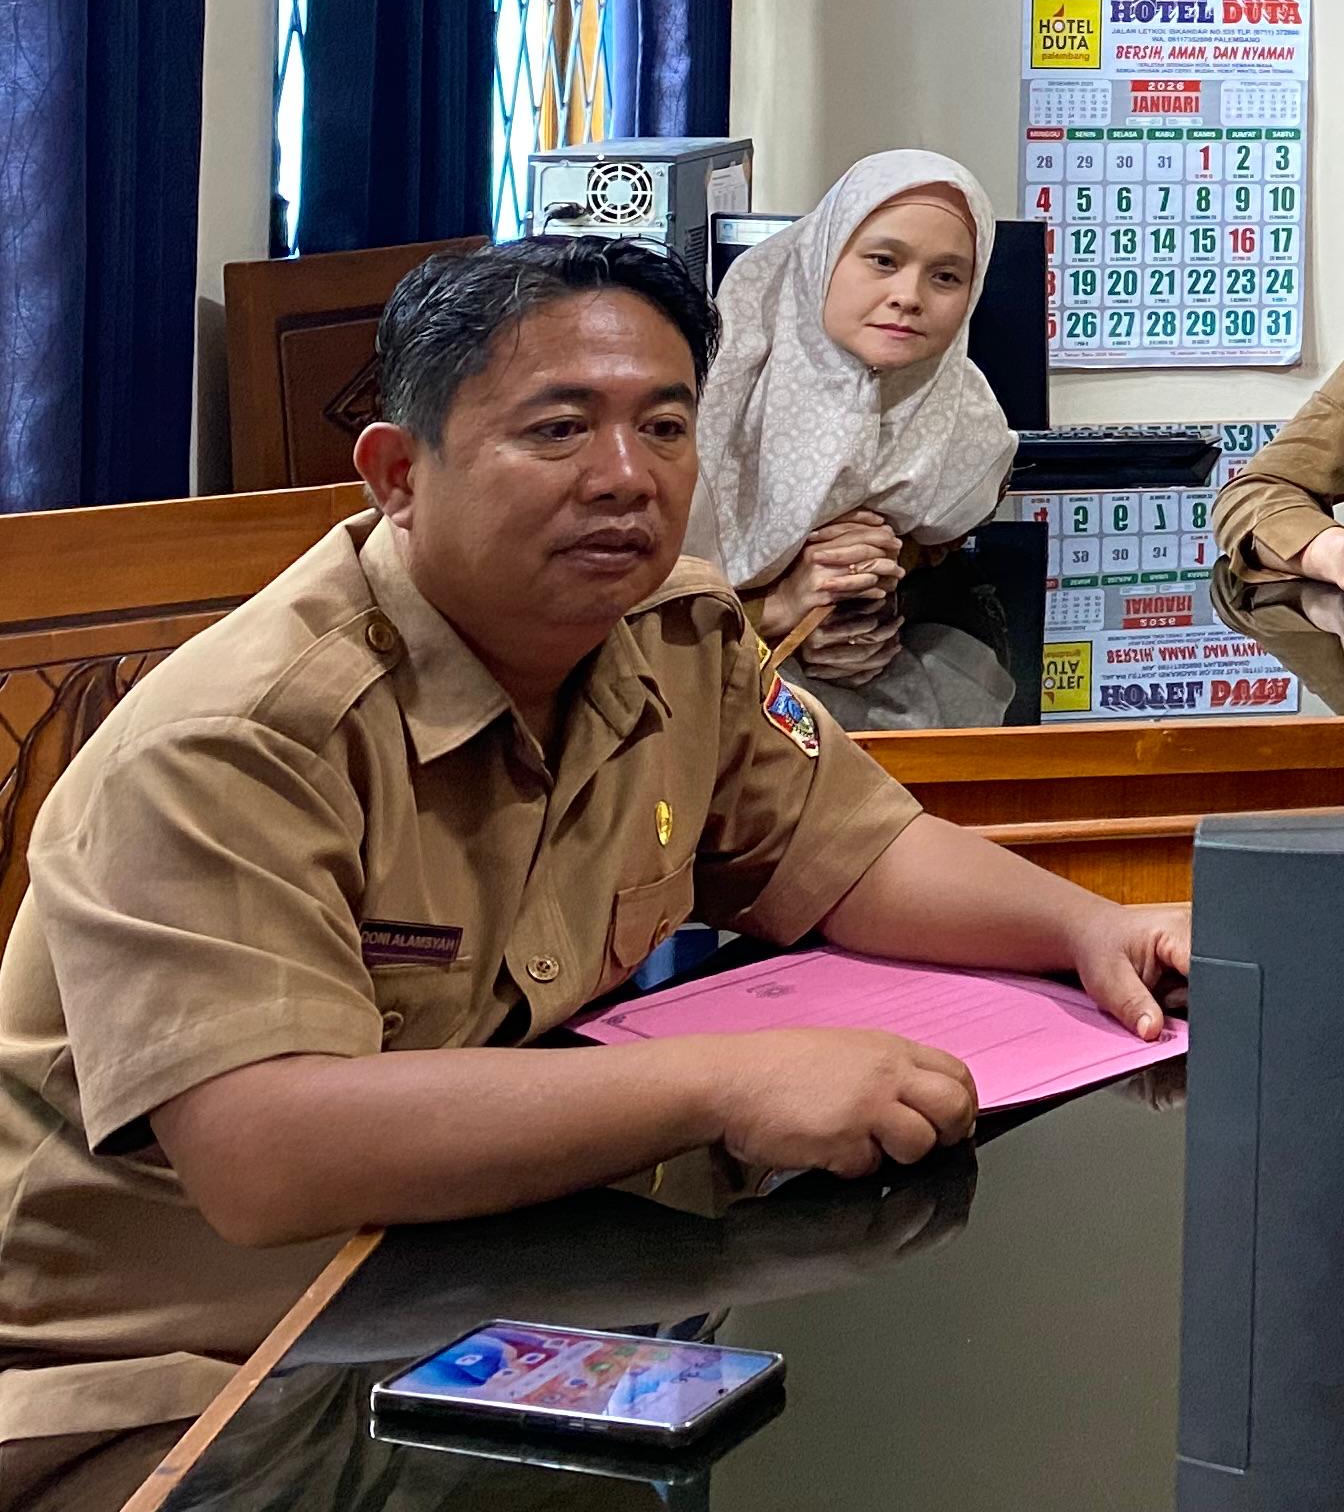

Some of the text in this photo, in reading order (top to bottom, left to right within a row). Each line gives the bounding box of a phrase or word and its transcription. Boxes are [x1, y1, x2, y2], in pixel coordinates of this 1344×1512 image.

[1039, 19, 1094, 34] HOTEL
[1042, 35, 1089, 50] DUTA
[1116, 45, 1295, 61] BERSIH, AMAN, DAN NYAMAN
[1042, 51, 1090, 62] palembang
[1147, 81, 1185, 91] 2026
[1131, 96, 1200, 113] JANUARI
[1036, 155, 1053, 169] 28
[1076, 155, 1094, 169] 29
[1116, 155, 1133, 169] 30
[1158, 155, 1172, 169] 31
[1199, 145, 1210, 171] 1
[1236, 145, 1251, 171] 2
[1275, 145, 1290, 171] 3
[1036, 186, 1052, 213] 4
[1077, 186, 1092, 213] 5
[1117, 186, 1132, 213] 6
[1158, 186, 1170, 213] 7
[1196, 186, 1211, 213] 8
[1235, 186, 1250, 213] 9
[1269, 186, 1295, 213] 10
[1070, 228, 1097, 254] 12
[1110, 228, 1137, 254] 13
[1150, 228, 1176, 254] 14
[1190, 228, 1216, 254] 15
[1228, 228, 1255, 254] 16
[1269, 228, 1293, 254] 17
[1069, 269, 1096, 296] 19
[1107, 269, 1138, 296] 20
[1150, 269, 1175, 296] 21
[1187, 269, 1217, 296] 22
[1226, 269, 1256, 296] 23
[1266, 269, 1294, 296] 24
[1066, 311, 1097, 338] 26
[1108, 311, 1135, 338] 27
[1146, 311, 1176, 338] 28
[1185, 310, 1216, 336] 29
[1225, 310, 1256, 336] 30
[1266, 310, 1292, 336] 31
[391, 933, 455, 951] ALAMSYAH
